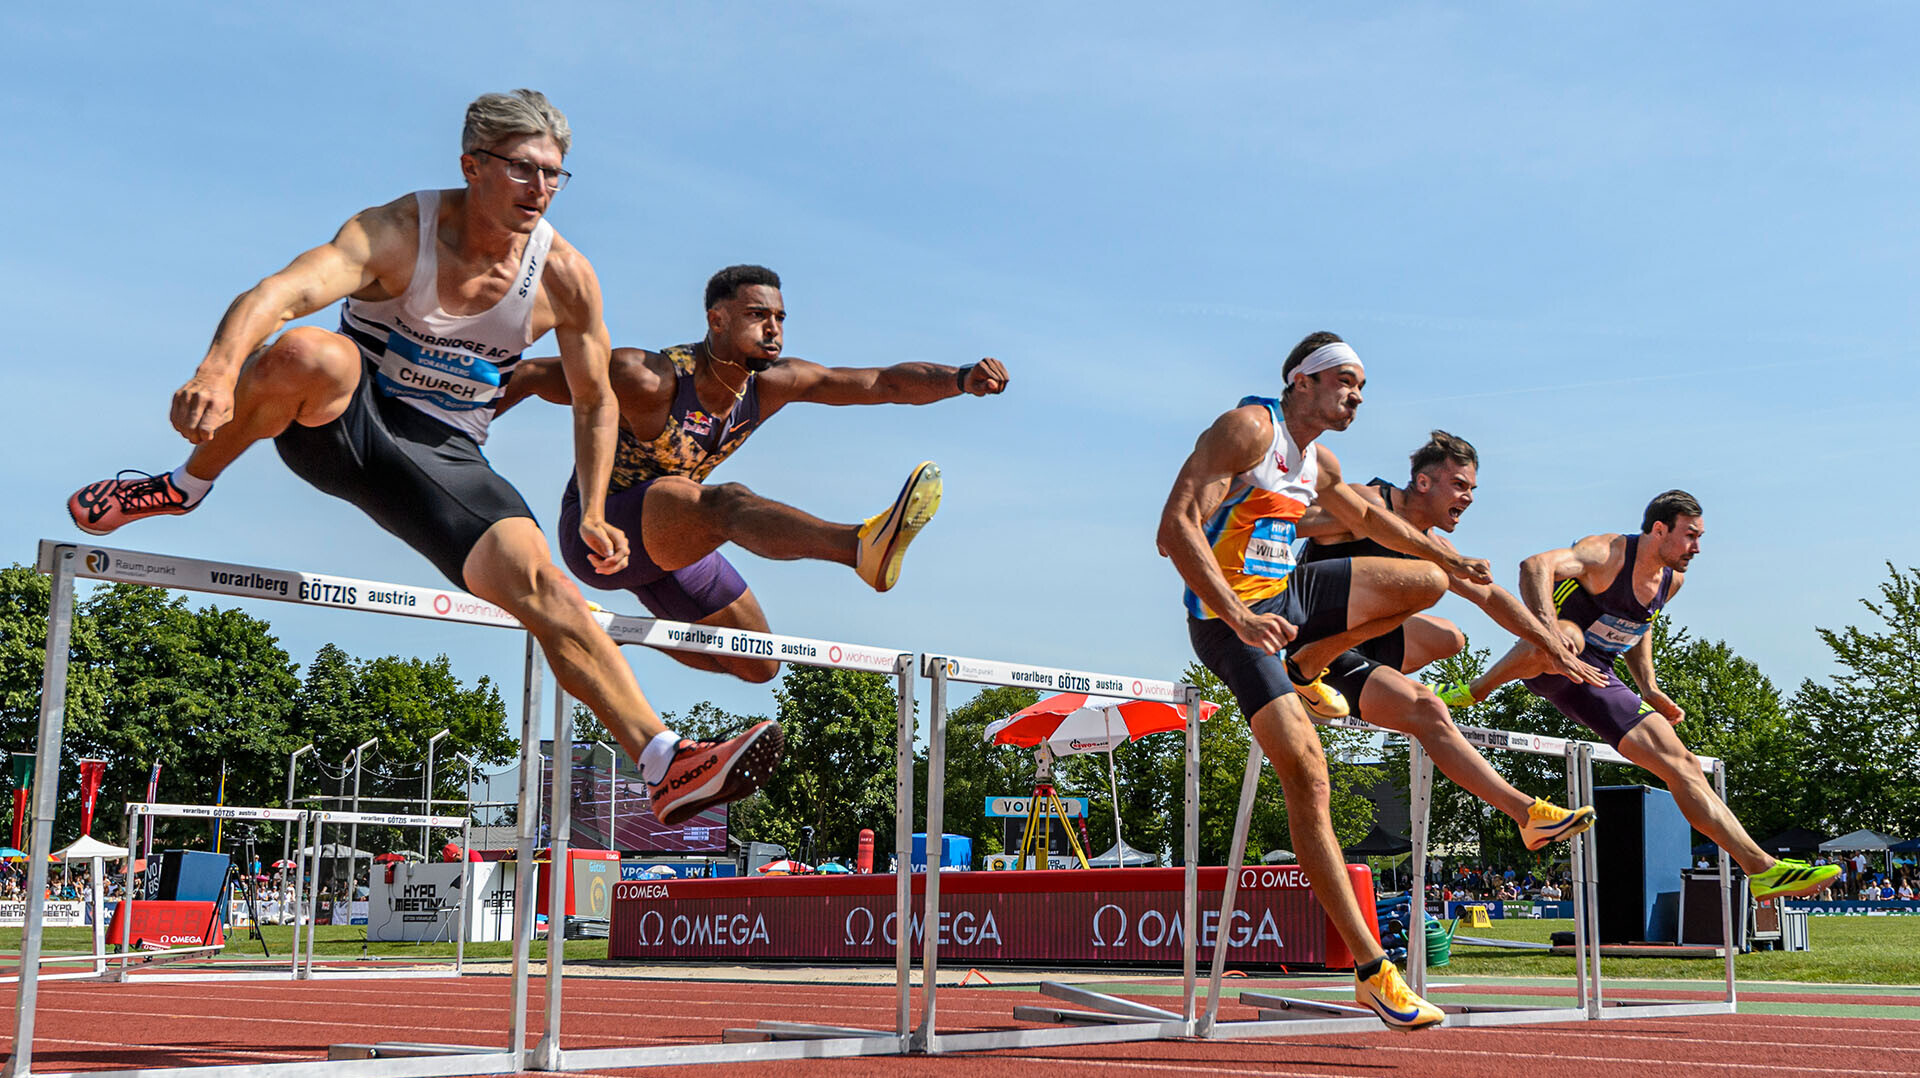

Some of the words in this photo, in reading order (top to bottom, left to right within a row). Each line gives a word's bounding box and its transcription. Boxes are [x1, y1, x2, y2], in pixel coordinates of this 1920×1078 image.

[518, 256, 537, 298] soar
[394, 316, 486, 355] TONBRIDGE
[486, 346, 510, 359] AC
[420, 346, 475, 367] HYPO
[400, 367, 478, 399] CHURCH
[115, 559, 176, 576] Raum.punkt
[210, 570, 289, 596] vorarlberg
[298, 578, 357, 605] GÖTZIS
[368, 590, 417, 607] austria
[455, 602, 515, 619] wohn.we
[667, 628, 724, 649] vorarlberg
[731, 634, 774, 656] GÖTZIS
[781, 643, 817, 657] austria
[844, 651, 895, 667] wohn.wert
[1010, 670, 1053, 686] vorarlberg
[1058, 673, 1090, 691] GÖTZIS
[1096, 679, 1123, 691] austria
[1144, 685, 1184, 698] wohn.wert
[1488, 732, 1508, 746] GÖTZIS
[1512, 737, 1529, 746] austria
[670, 754, 719, 790] balance
[183, 808, 210, 816] vorarlberg
[213, 809, 236, 817] GÖTZIS
[387, 816, 407, 824] GÖTZIS
[1261, 870, 1310, 888] OMEG
[404, 885, 436, 898] HYPO
[629, 884, 669, 899] OMEGA
[671, 911, 770, 946] OMEGA
[170, 935, 203, 944] OMEGA
